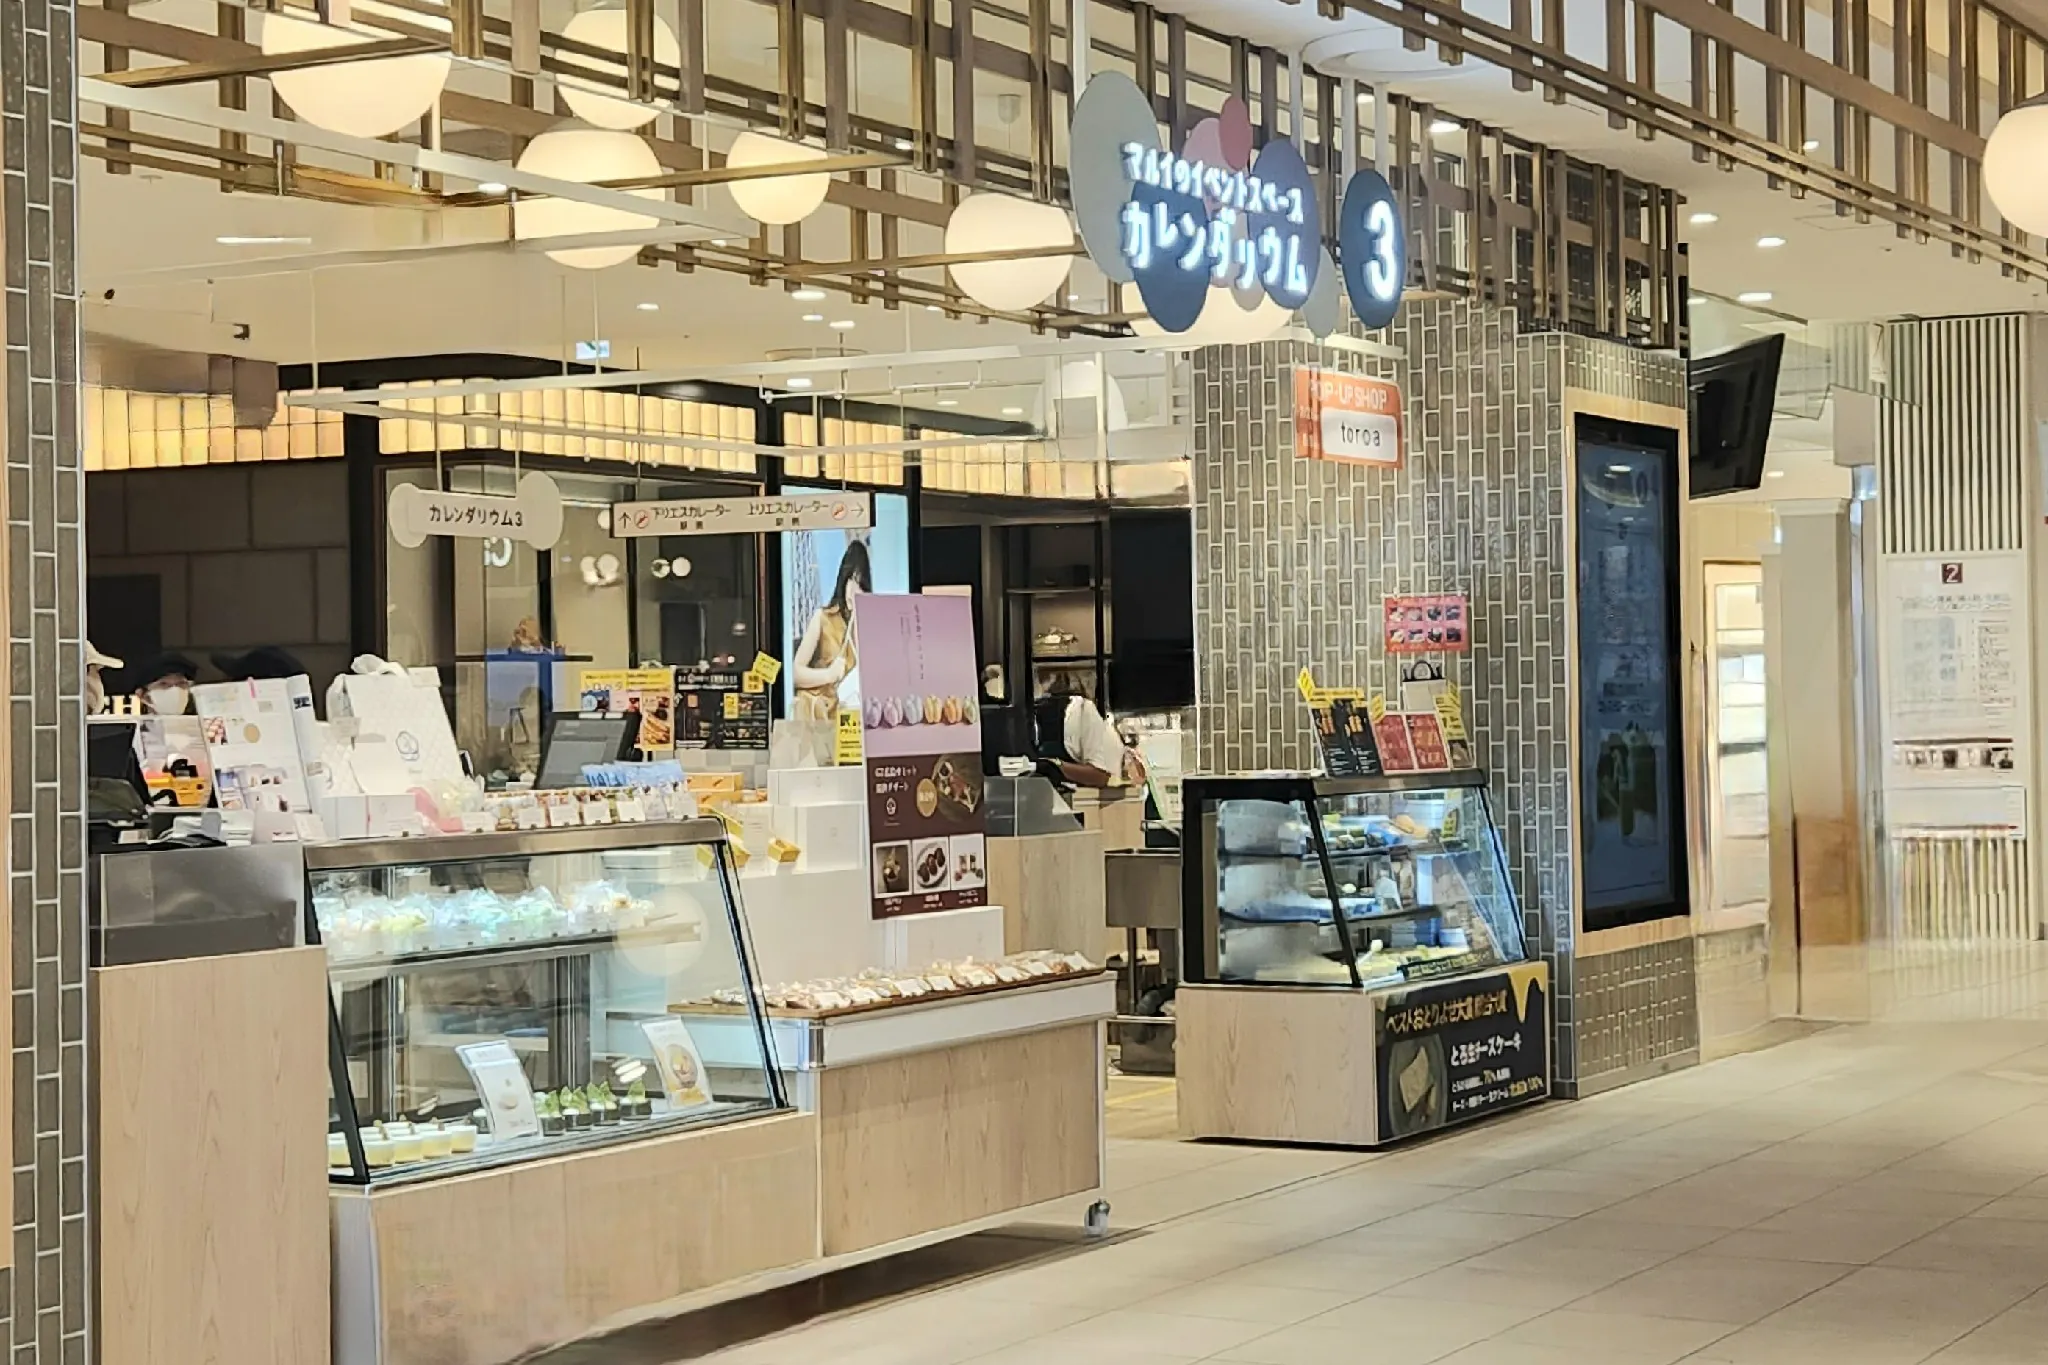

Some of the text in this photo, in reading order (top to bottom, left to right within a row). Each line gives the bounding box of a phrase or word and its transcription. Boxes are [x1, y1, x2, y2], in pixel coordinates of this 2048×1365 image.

[1122, 140, 1304, 224] マルイのイベントスペース
[1121, 199, 1397, 301] カレンダリウム 3
[1340, 421, 1381, 447] toroa
[428, 503, 523, 527] カレンダリウム3
[1945, 563, 1960, 584] 2
